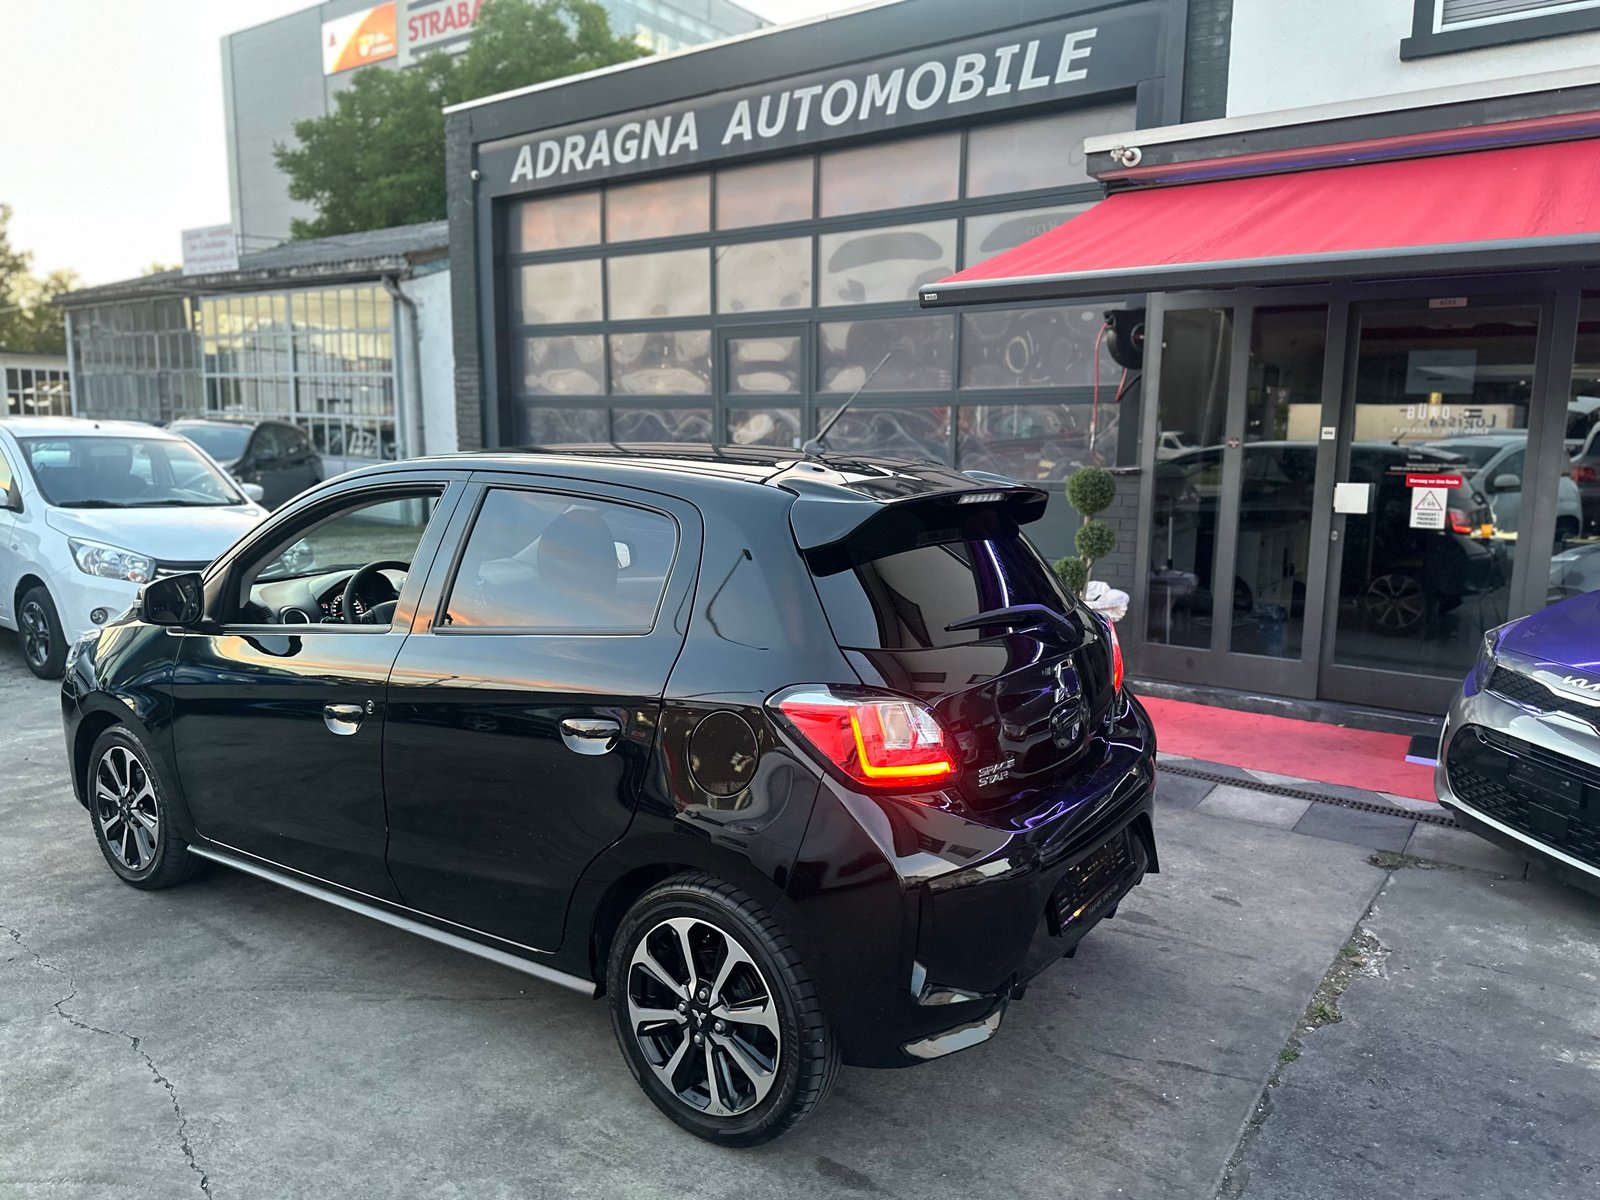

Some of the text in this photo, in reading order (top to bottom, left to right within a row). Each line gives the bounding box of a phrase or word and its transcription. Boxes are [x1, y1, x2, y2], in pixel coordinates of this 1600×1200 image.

[510, 28, 1098, 184] ADRAGNA AUTOMOBILE
[1409, 477, 1428, 485] Warnung
[1562, 675, 1600, 692] KIA
[978, 758, 1016, 778] SPACE
[978, 770, 1009, 787] STAR
